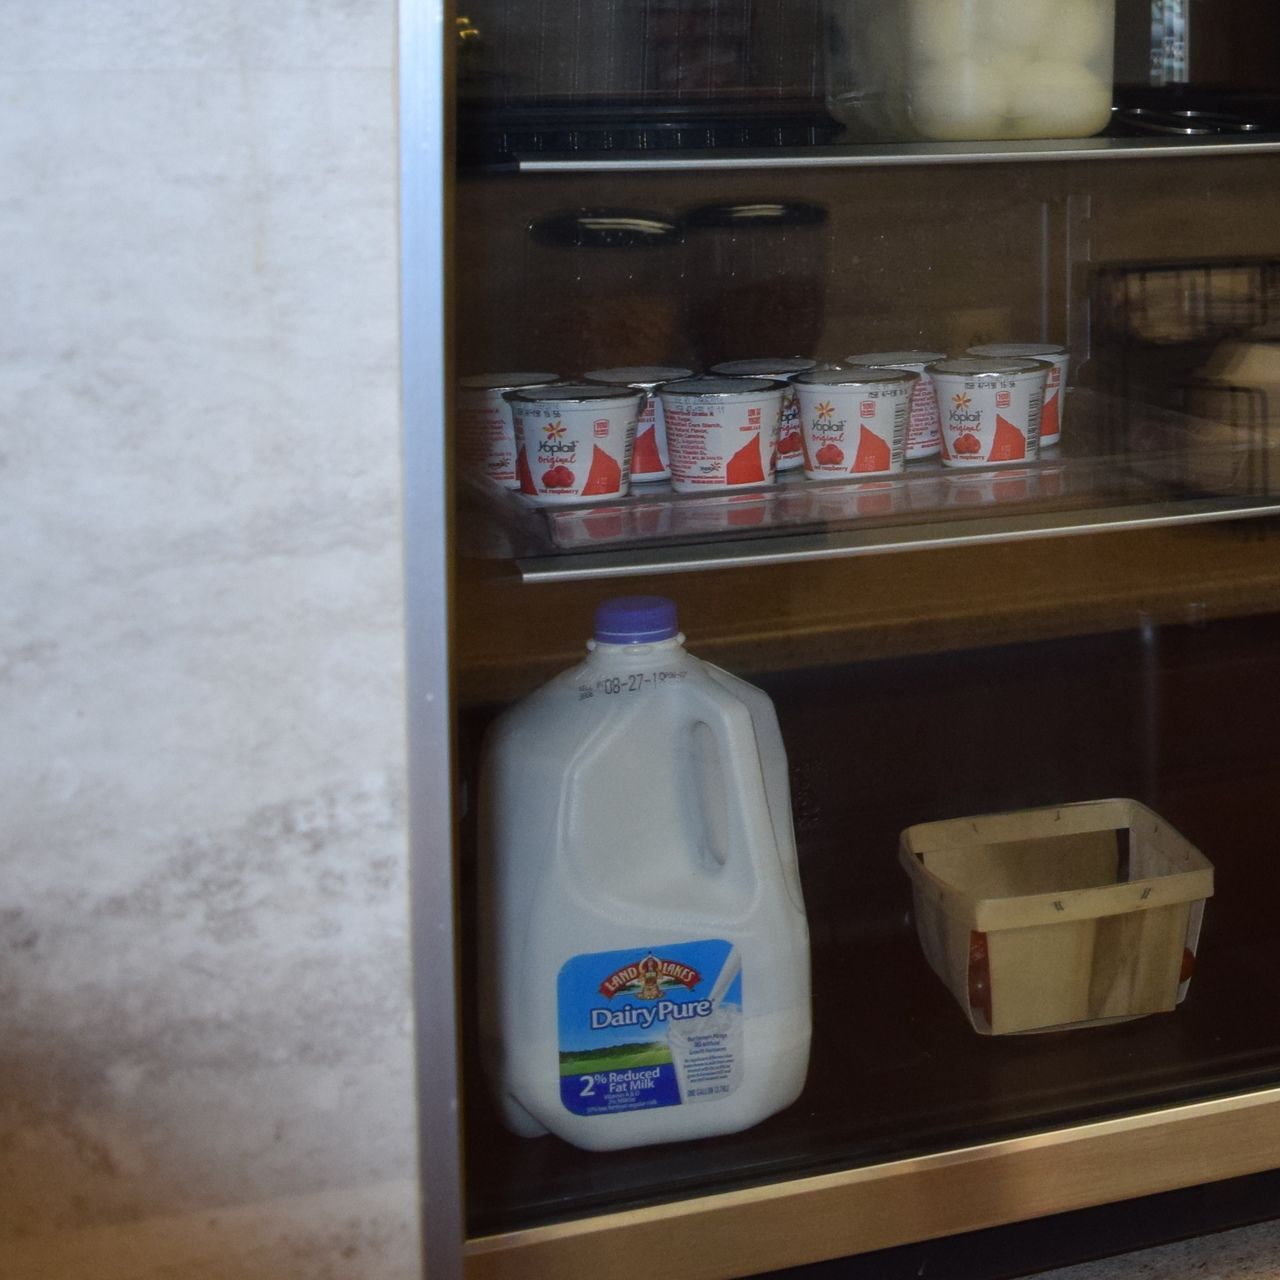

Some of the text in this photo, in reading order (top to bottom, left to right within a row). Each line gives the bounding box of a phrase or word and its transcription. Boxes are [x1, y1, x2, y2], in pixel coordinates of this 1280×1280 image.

[949, 409, 981, 424] Yoplait
[811, 419, 845, 434] Yoplait
[538, 439, 576, 456] Yoplait
[603, 966, 638, 991] LAND
[662, 962, 696, 983] LAKES
[579, 1067, 660, 1097] 2% Reduced
[609, 1077, 655, 1093] Fat Milk
